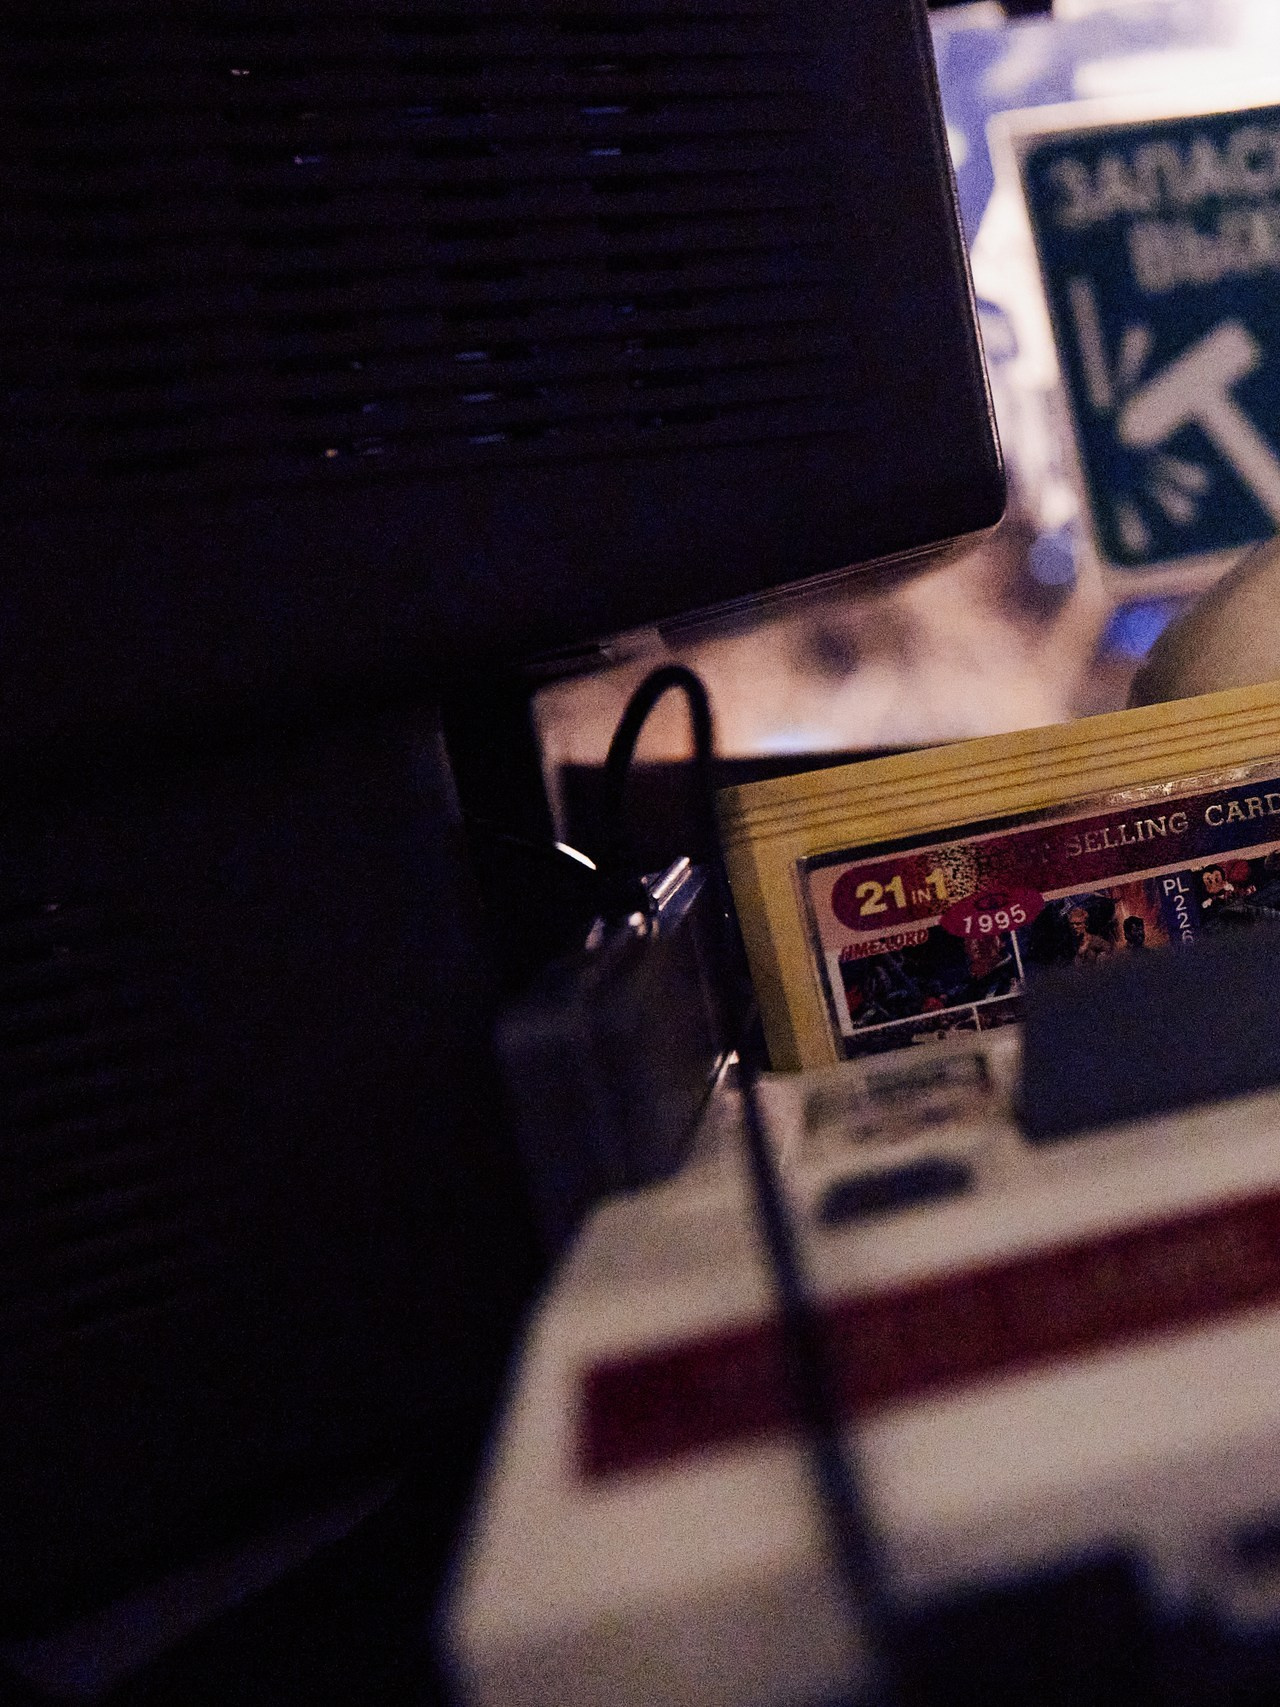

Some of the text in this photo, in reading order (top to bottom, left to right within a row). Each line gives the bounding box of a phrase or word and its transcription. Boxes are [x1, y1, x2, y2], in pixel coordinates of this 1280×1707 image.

[1066, 811, 1188, 857] SELLING
[855, 868, 948, 917] 21 IN 1
[962, 904, 1027, 934] 1995
